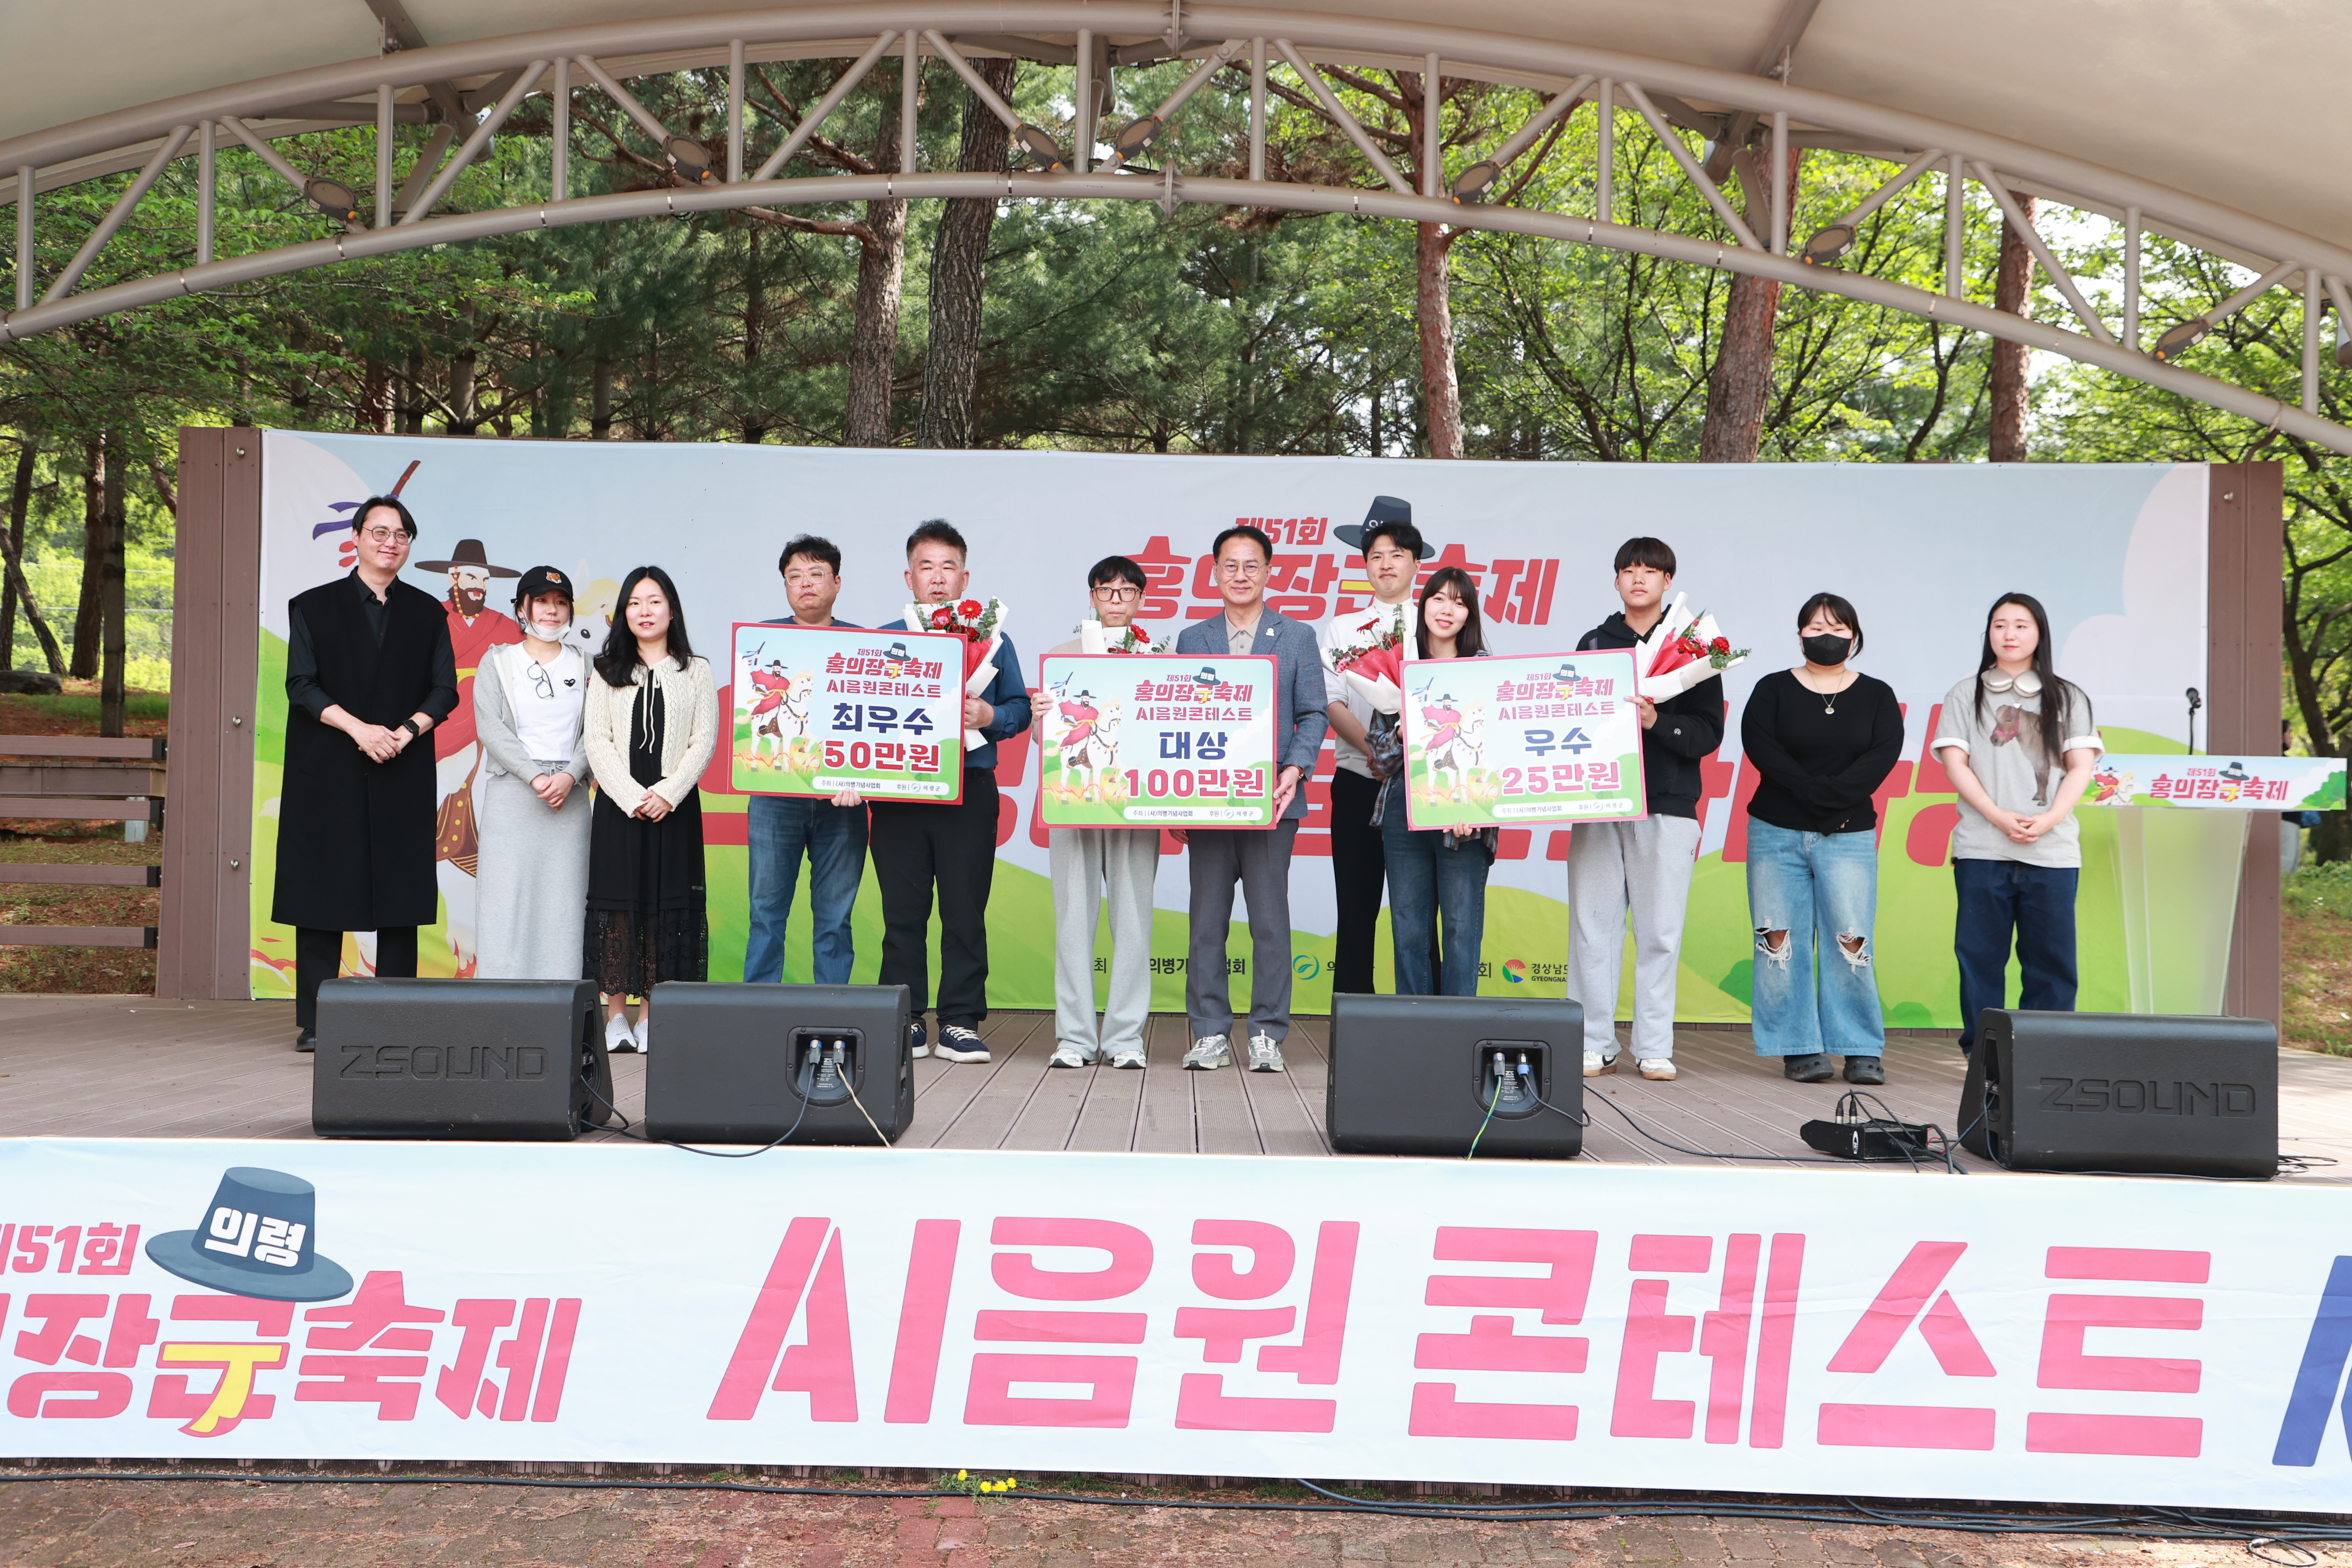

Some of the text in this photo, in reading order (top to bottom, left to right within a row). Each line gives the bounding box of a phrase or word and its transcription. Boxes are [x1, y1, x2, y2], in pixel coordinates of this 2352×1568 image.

[826, 652, 943, 679] 홍의장군축제
[857, 648, 883, 656] 제51회
[890, 647, 905, 657] 의령
[1166, 674, 1192, 682] 제51회
[1199, 671, 1215, 682] 의령
[1527, 673, 1551, 681] 제51회
[1559, 668, 1575, 678] 의령
[1135, 680, 1253, 704] 홍의장군축제
[1496, 677, 1614, 702] 홍의장군축제
[832, 703, 934, 736] 최우수
[1159, 731, 1228, 760] 대상
[1524, 727, 1592, 757] 우수
[824, 740, 940, 773] 50만원
[1124, 769, 1264, 797] 100만원
[1501, 761, 1620, 795] 25만원
[2186, 768, 2217, 777] 제51회
[2149, 774, 2290, 802] 홍의장군축제
[1094, 957, 1107, 974] 최
[340, 1045, 549, 1081] ZSOUND
[2039, 1077, 2256, 1118] ZSOUND
[204, 1207, 307, 1268] 의령
[706, 1216, 1361, 1433] AI음원
[1408, 1226, 2211, 1458] 콘테스트
[0, 1270, 582, 1438] 장군축제
